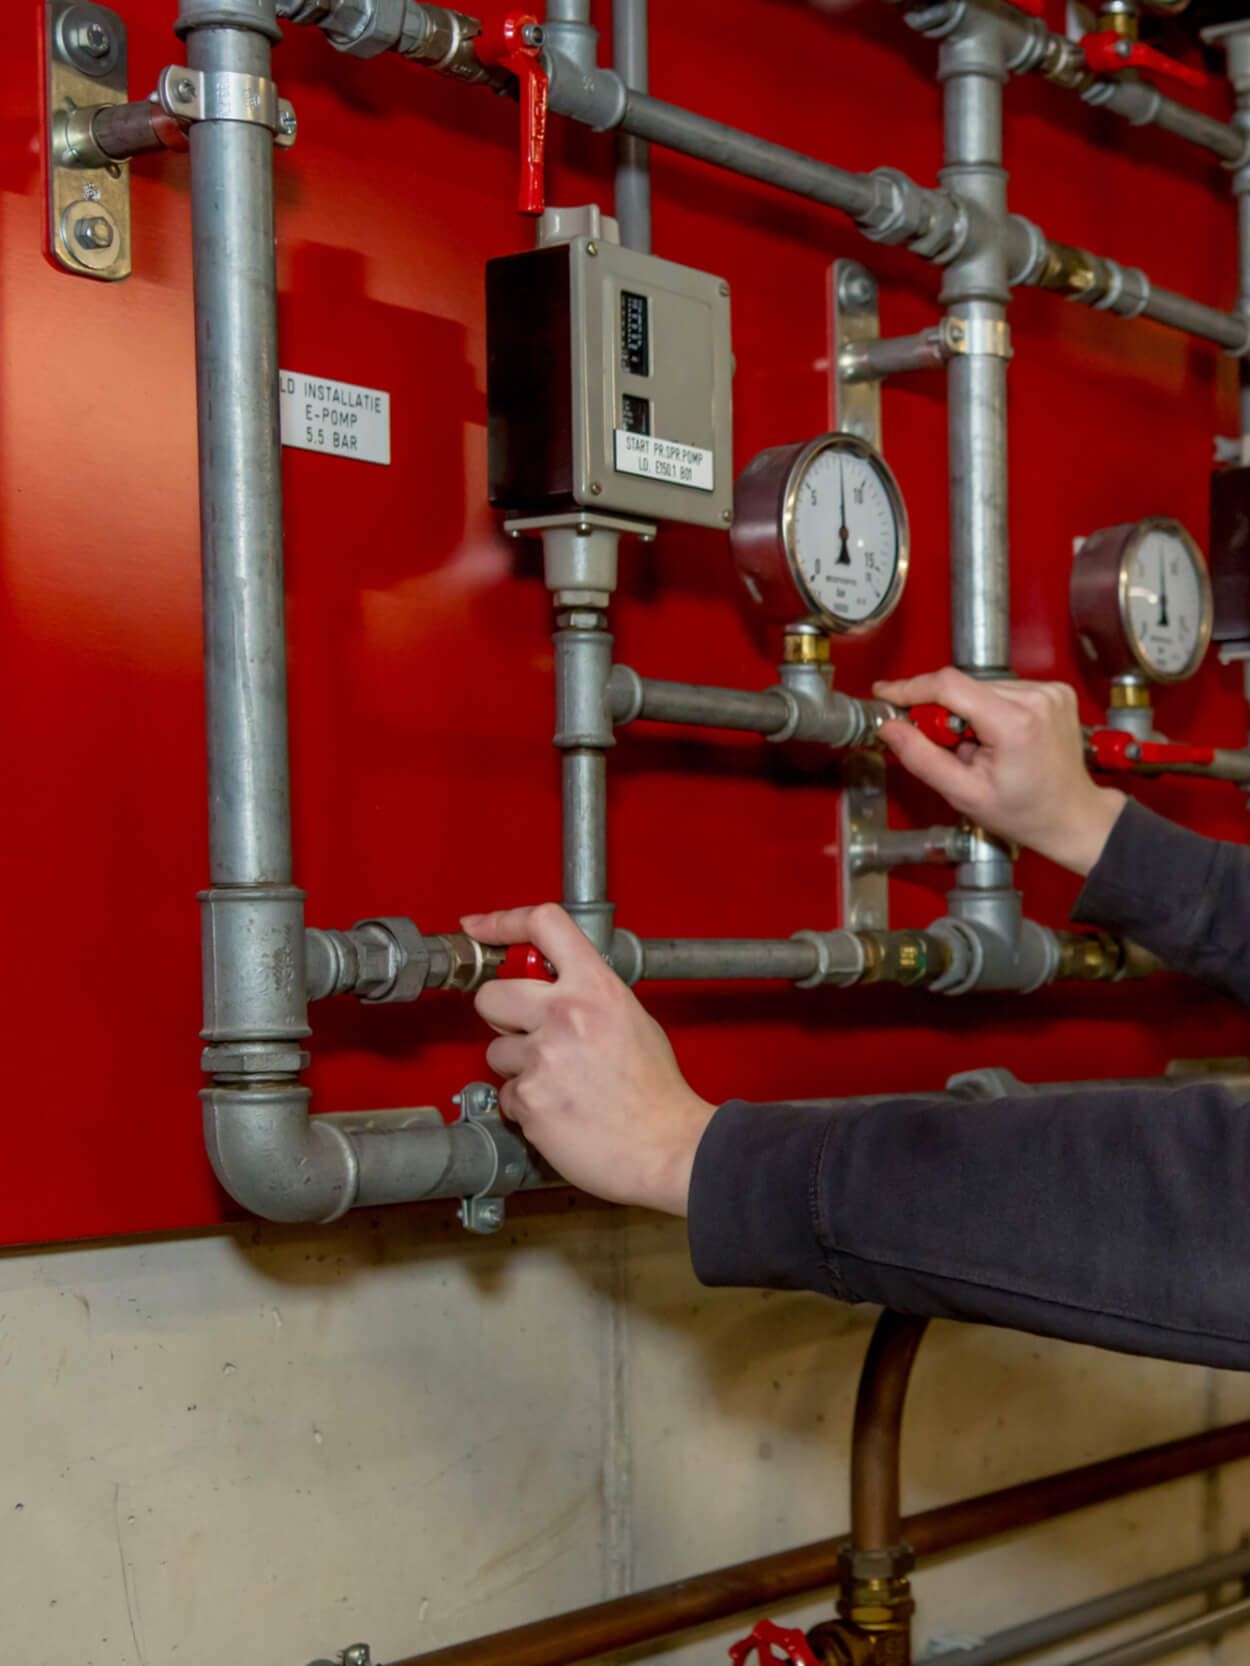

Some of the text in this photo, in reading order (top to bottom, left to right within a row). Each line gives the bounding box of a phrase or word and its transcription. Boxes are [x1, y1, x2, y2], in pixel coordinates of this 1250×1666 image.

[279, 377, 383, 414] LD INSTALLATIE
[305, 403, 359, 428] E-POMP
[306, 426, 359, 451] 5.5 BAR
[625, 435, 650, 454] START
